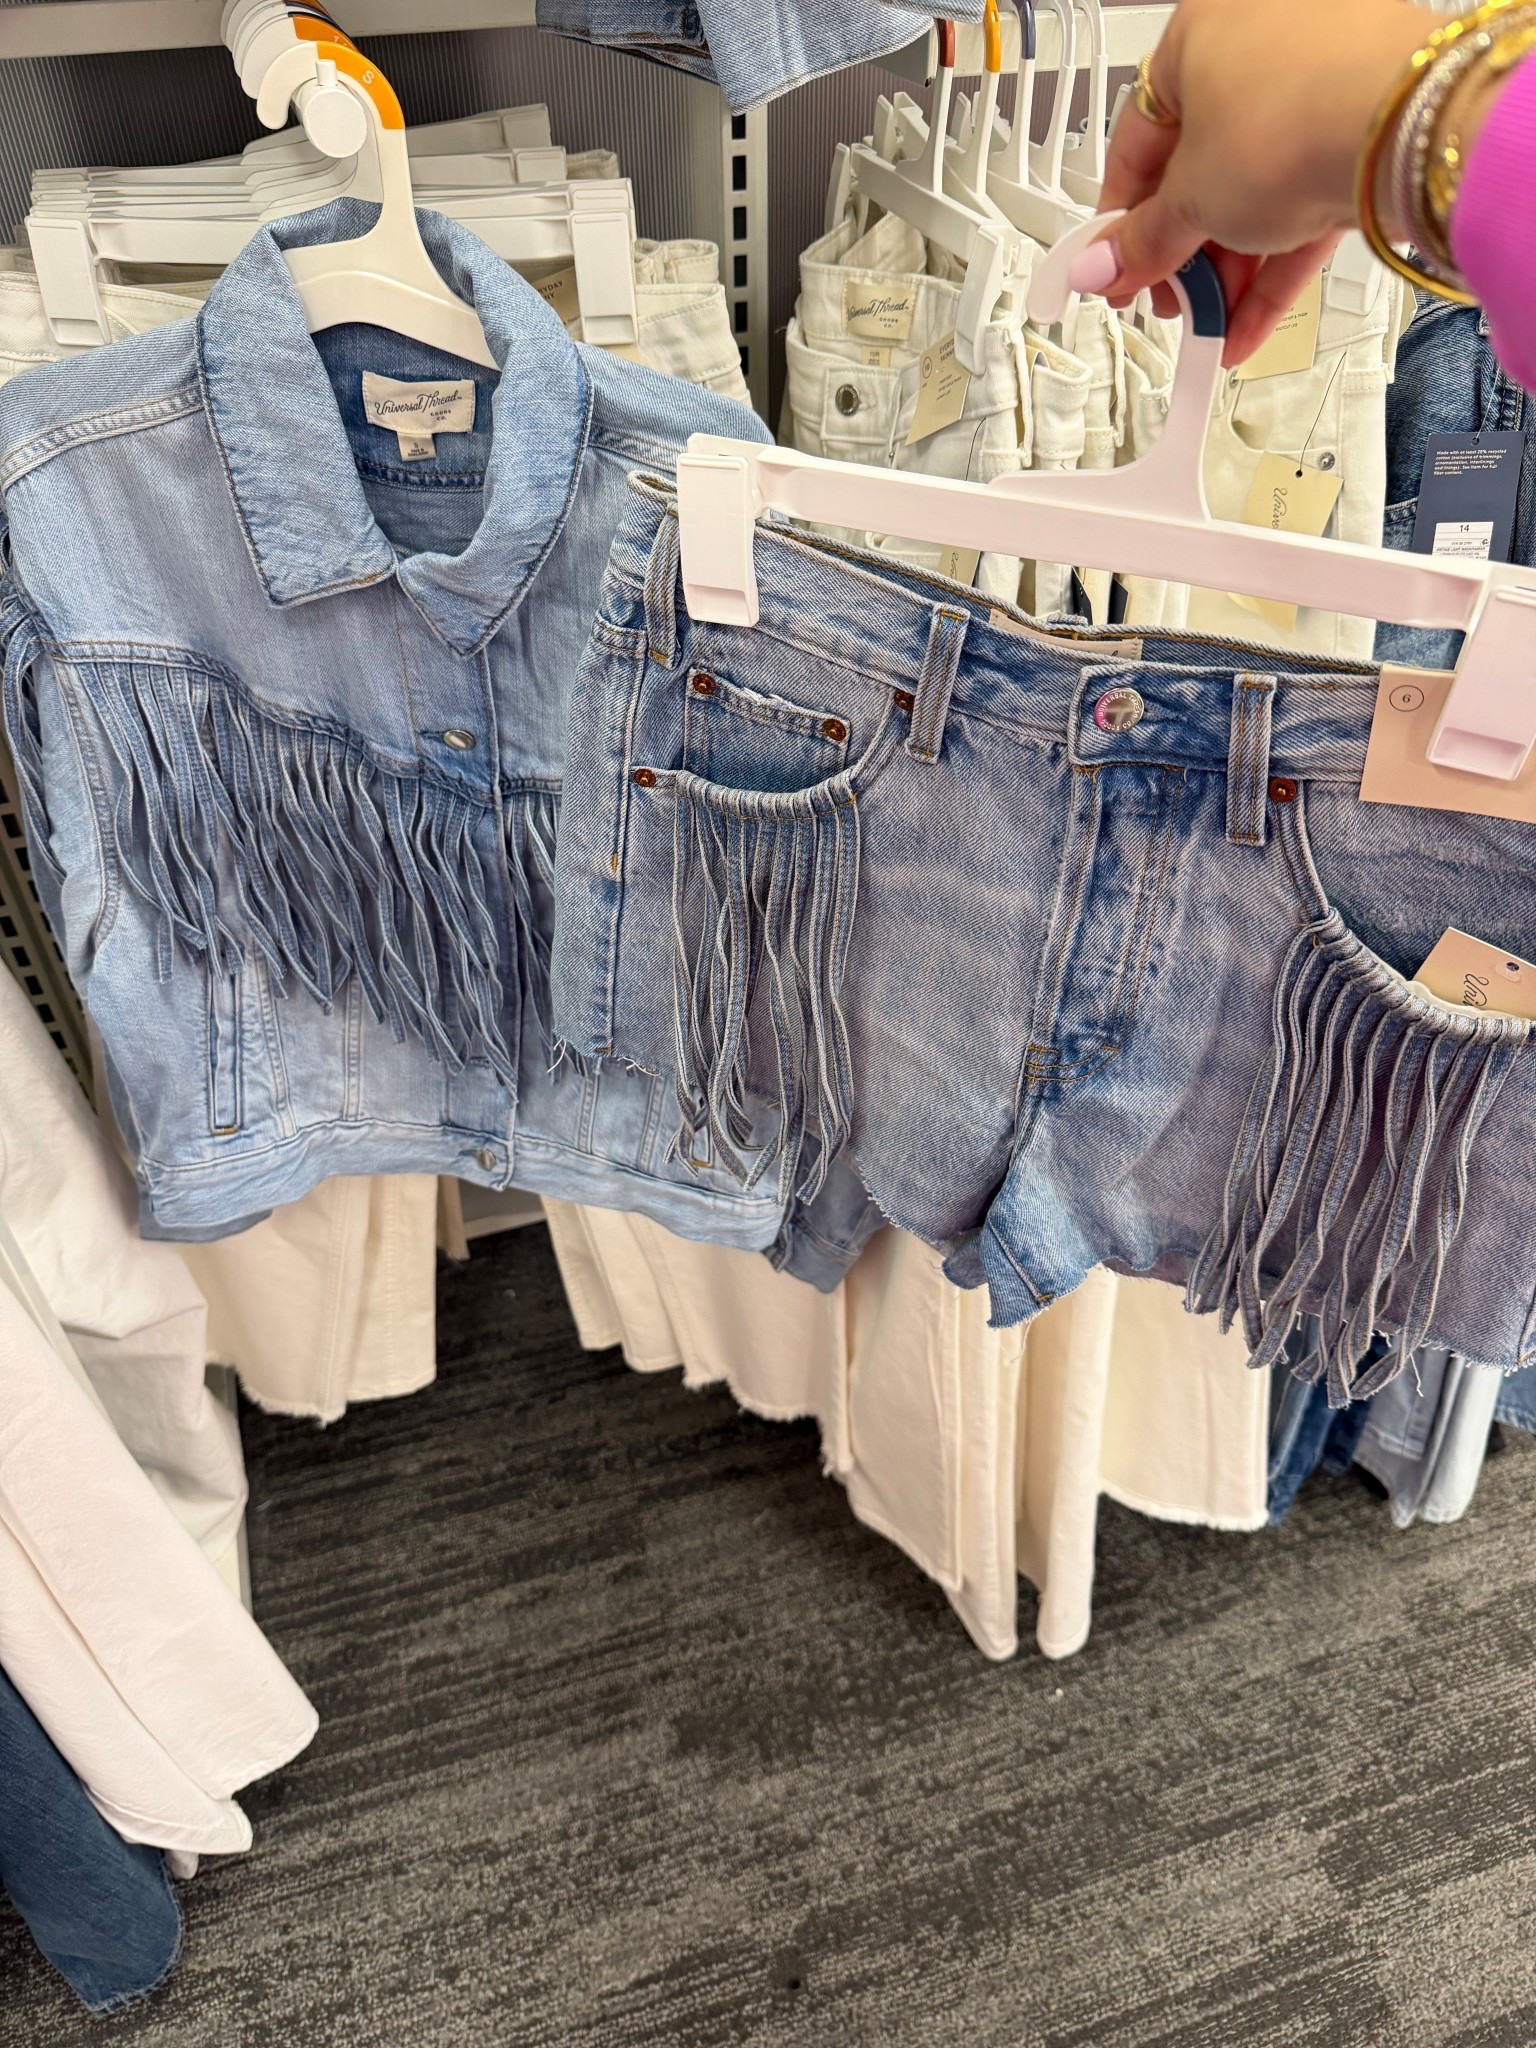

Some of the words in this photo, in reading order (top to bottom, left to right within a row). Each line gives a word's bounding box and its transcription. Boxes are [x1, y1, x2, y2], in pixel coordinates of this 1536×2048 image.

[362, 70, 375, 85] S
[870, 297, 908, 317] Thread
[374, 397, 424, 416] Universal
[416, 389, 459, 414] Thread
[430, 409, 452, 417] GOODS
[1272, 487, 1288, 529] Unive
[1459, 524, 1470, 533] 14
[1402, 693, 1412, 704] 6
